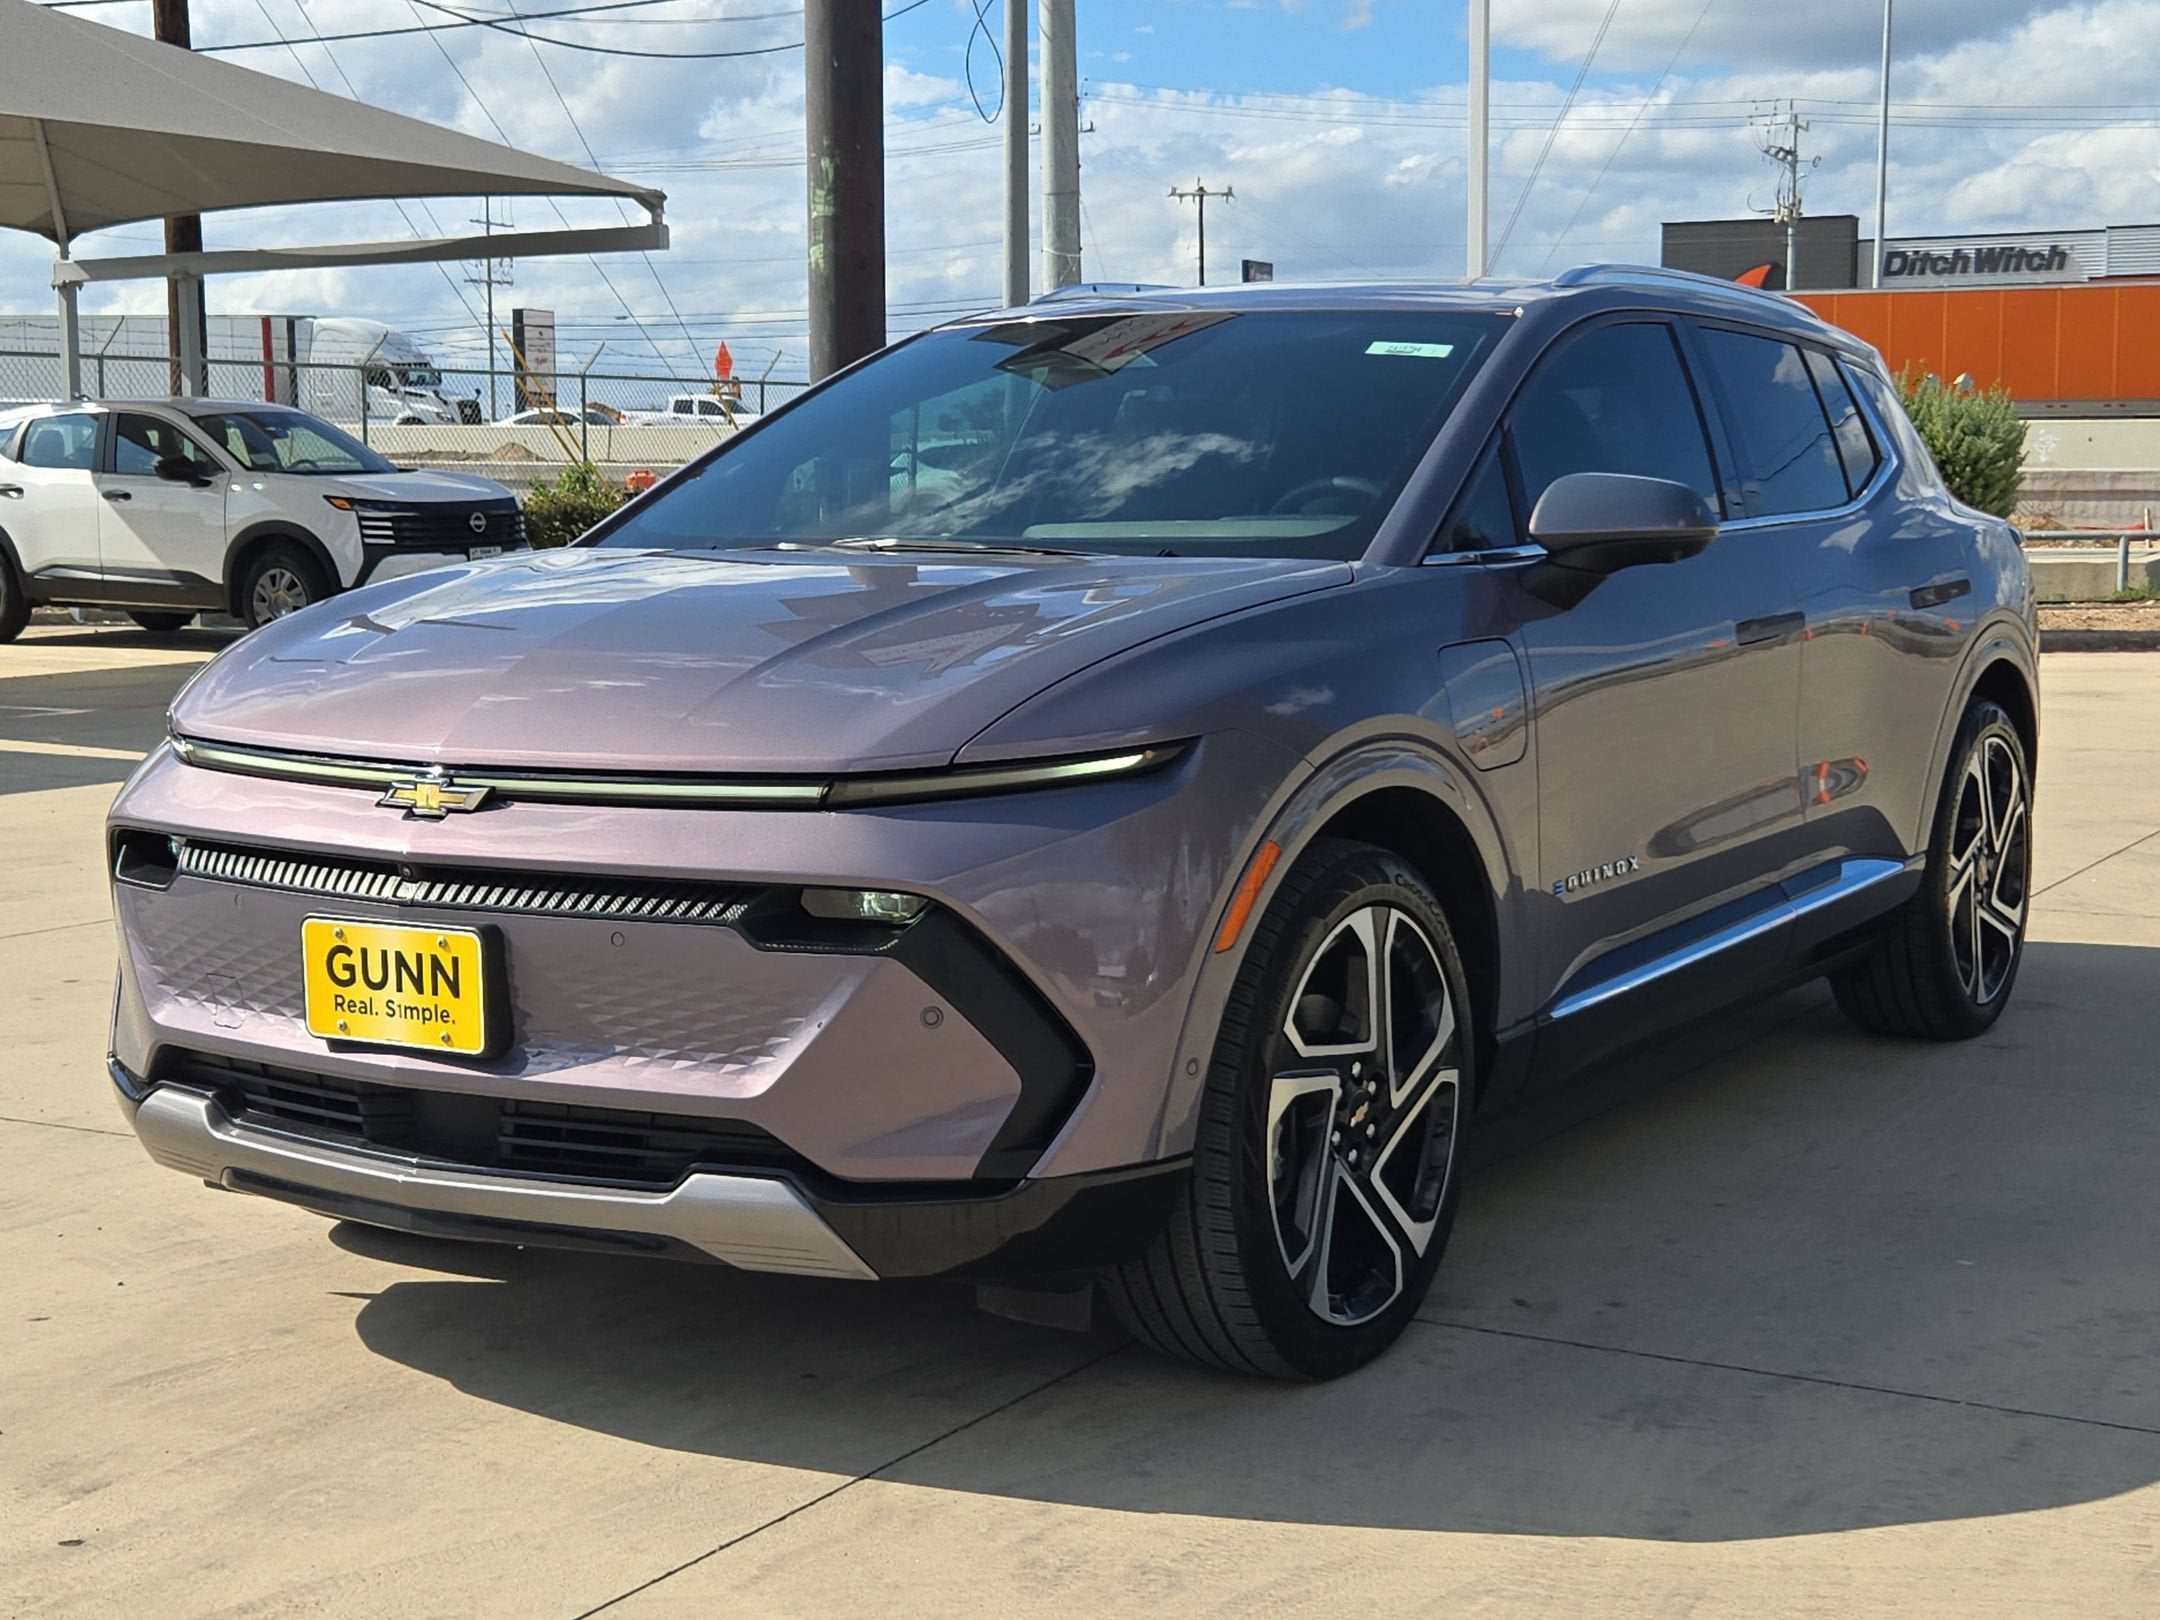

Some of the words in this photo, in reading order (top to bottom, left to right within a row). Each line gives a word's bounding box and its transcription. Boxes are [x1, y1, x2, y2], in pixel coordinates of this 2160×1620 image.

[1883, 249, 1971, 277] Ditch
[1974, 245, 2067, 273] Witch
[1552, 856, 1639, 897] EQUINOX
[326, 944, 461, 999] GUNN
[334, 993, 379, 1016] Real.
